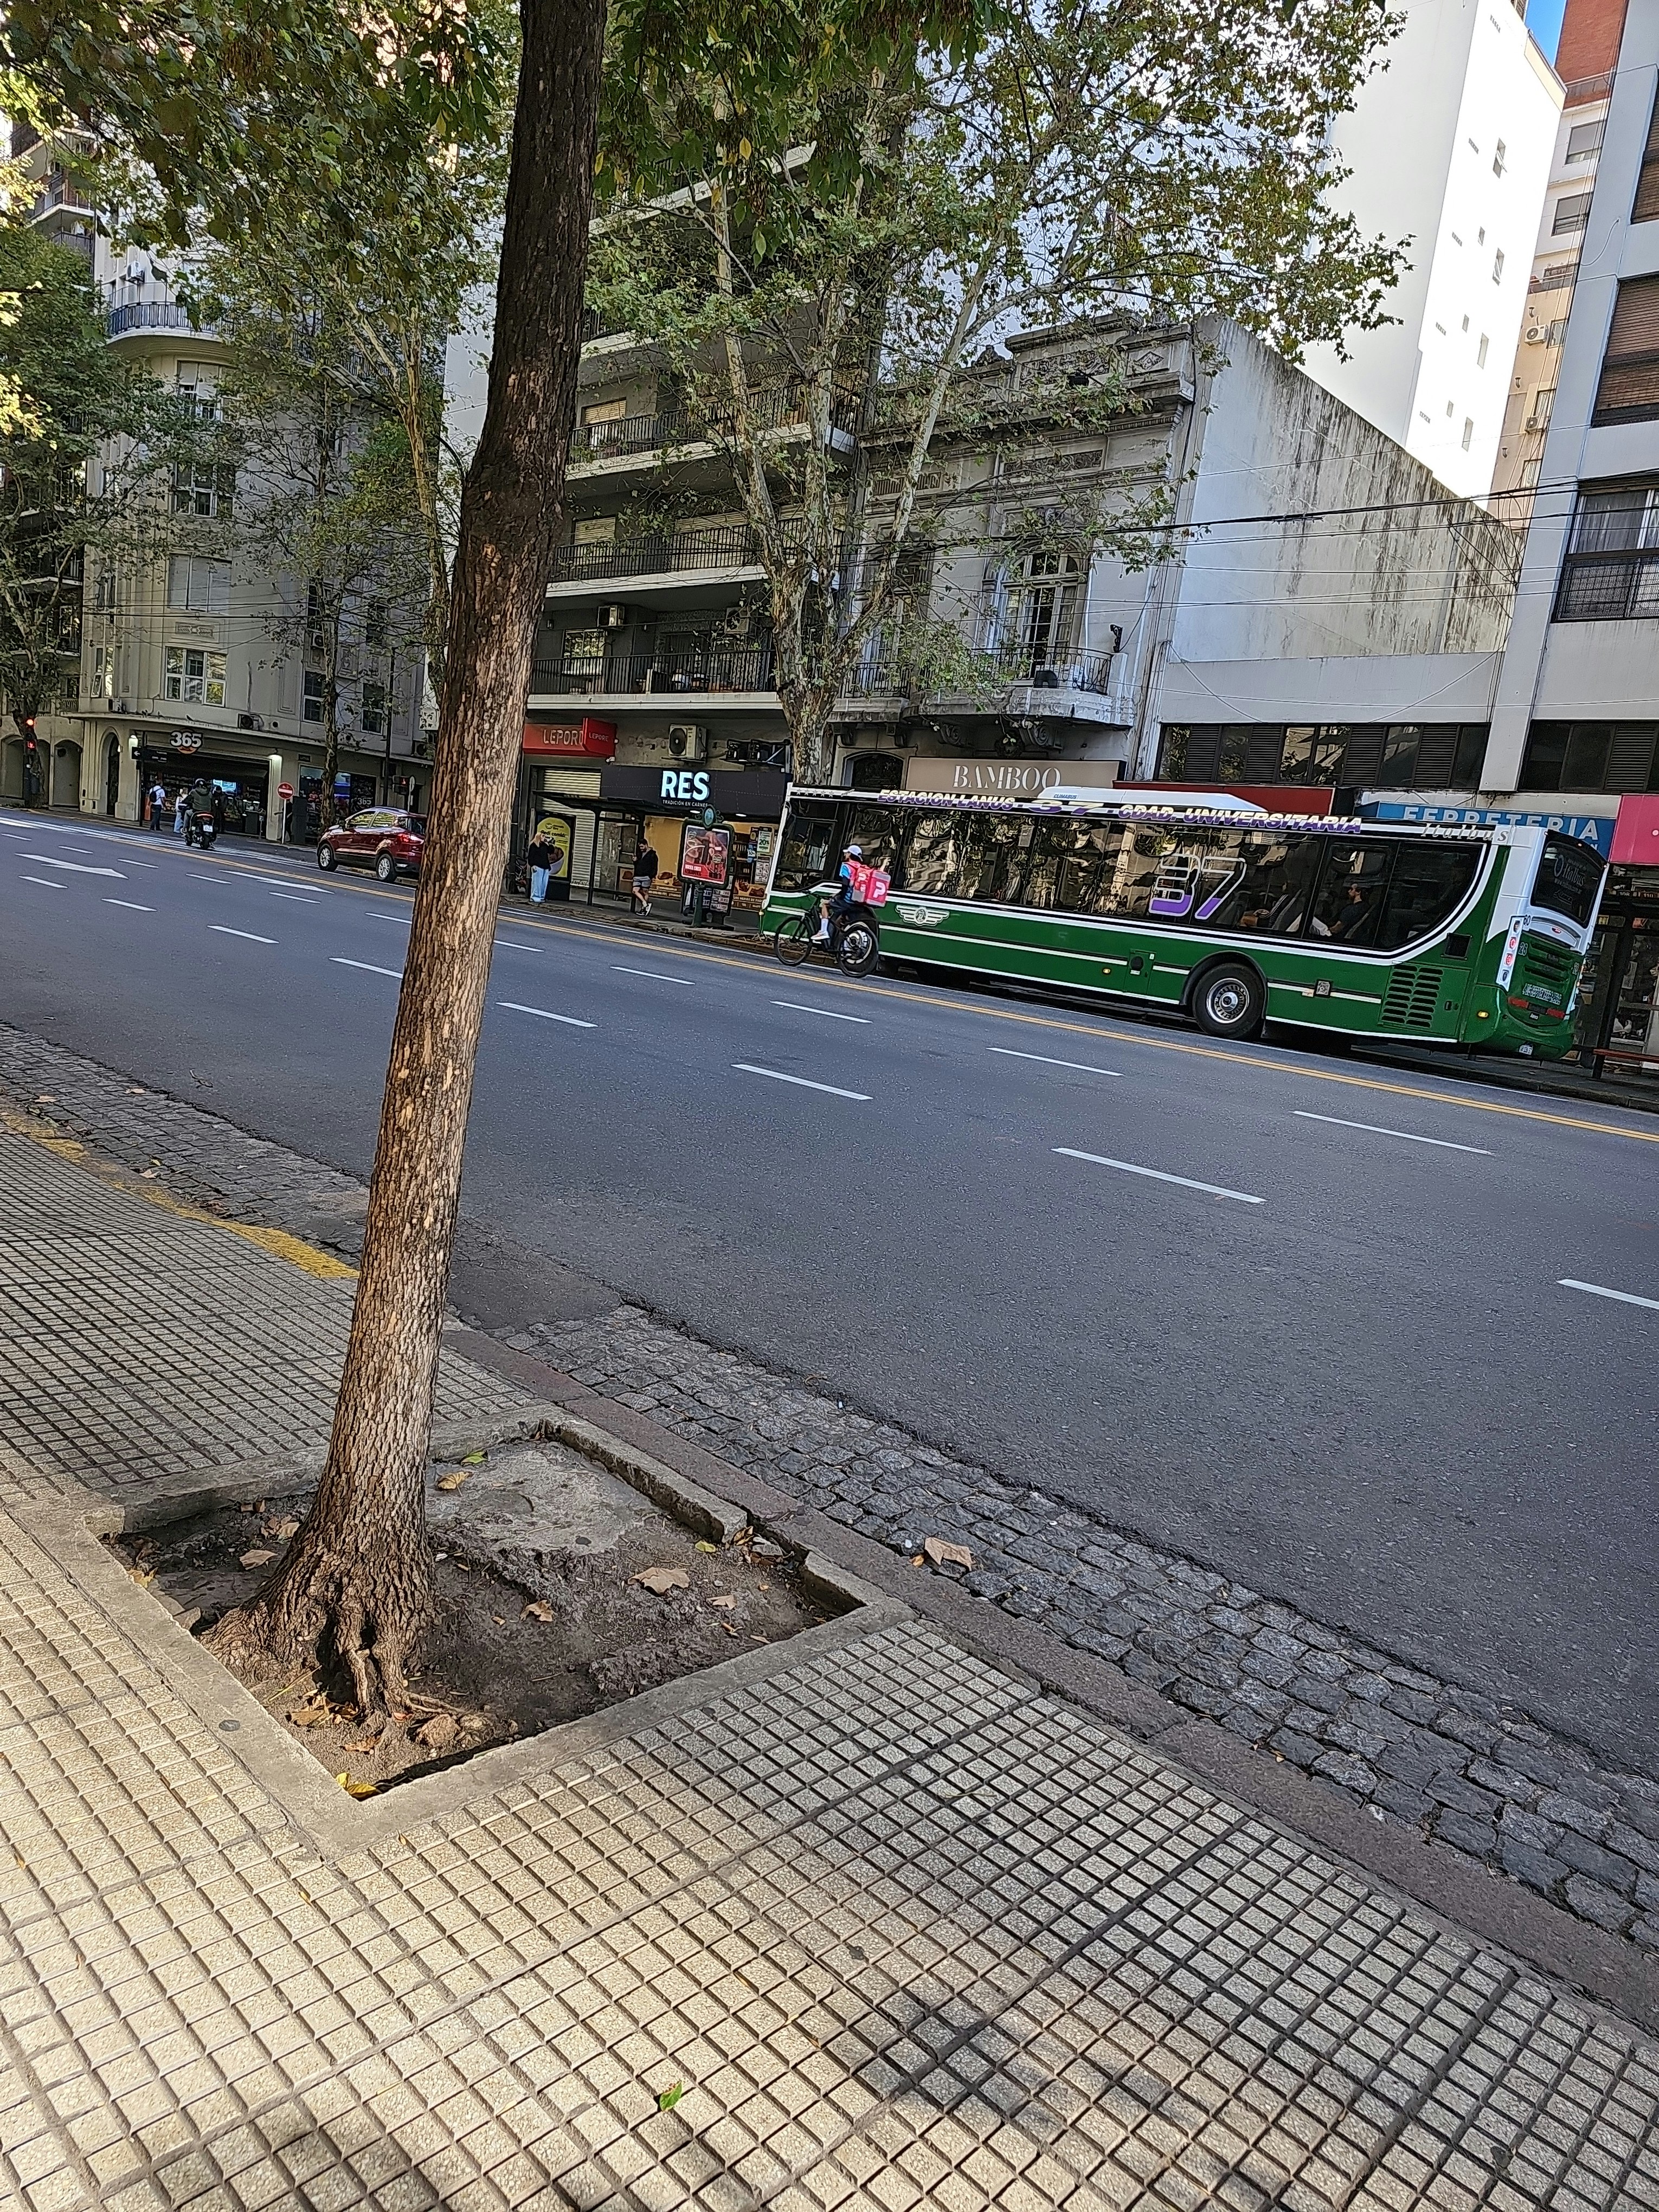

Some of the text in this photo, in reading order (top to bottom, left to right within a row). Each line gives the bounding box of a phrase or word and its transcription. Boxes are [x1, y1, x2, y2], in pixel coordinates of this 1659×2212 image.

[170, 731, 202, 748] 365
[589, 732, 609, 742] LEPORE
[661, 770, 710, 800] RES
[953, 766, 1060, 790] BAMBOO
[877, 789, 956, 807] ESTACION
[956, 795, 1015, 810] LANUS
[1028, 799, 1104, 815] 37
[1118, 804, 1175, 821] CDAD.
[1184, 807, 1363, 834] UNIVERSITARIA
[1420, 823, 1509, 841] Italbus
[1149, 853, 1246, 920] 37
